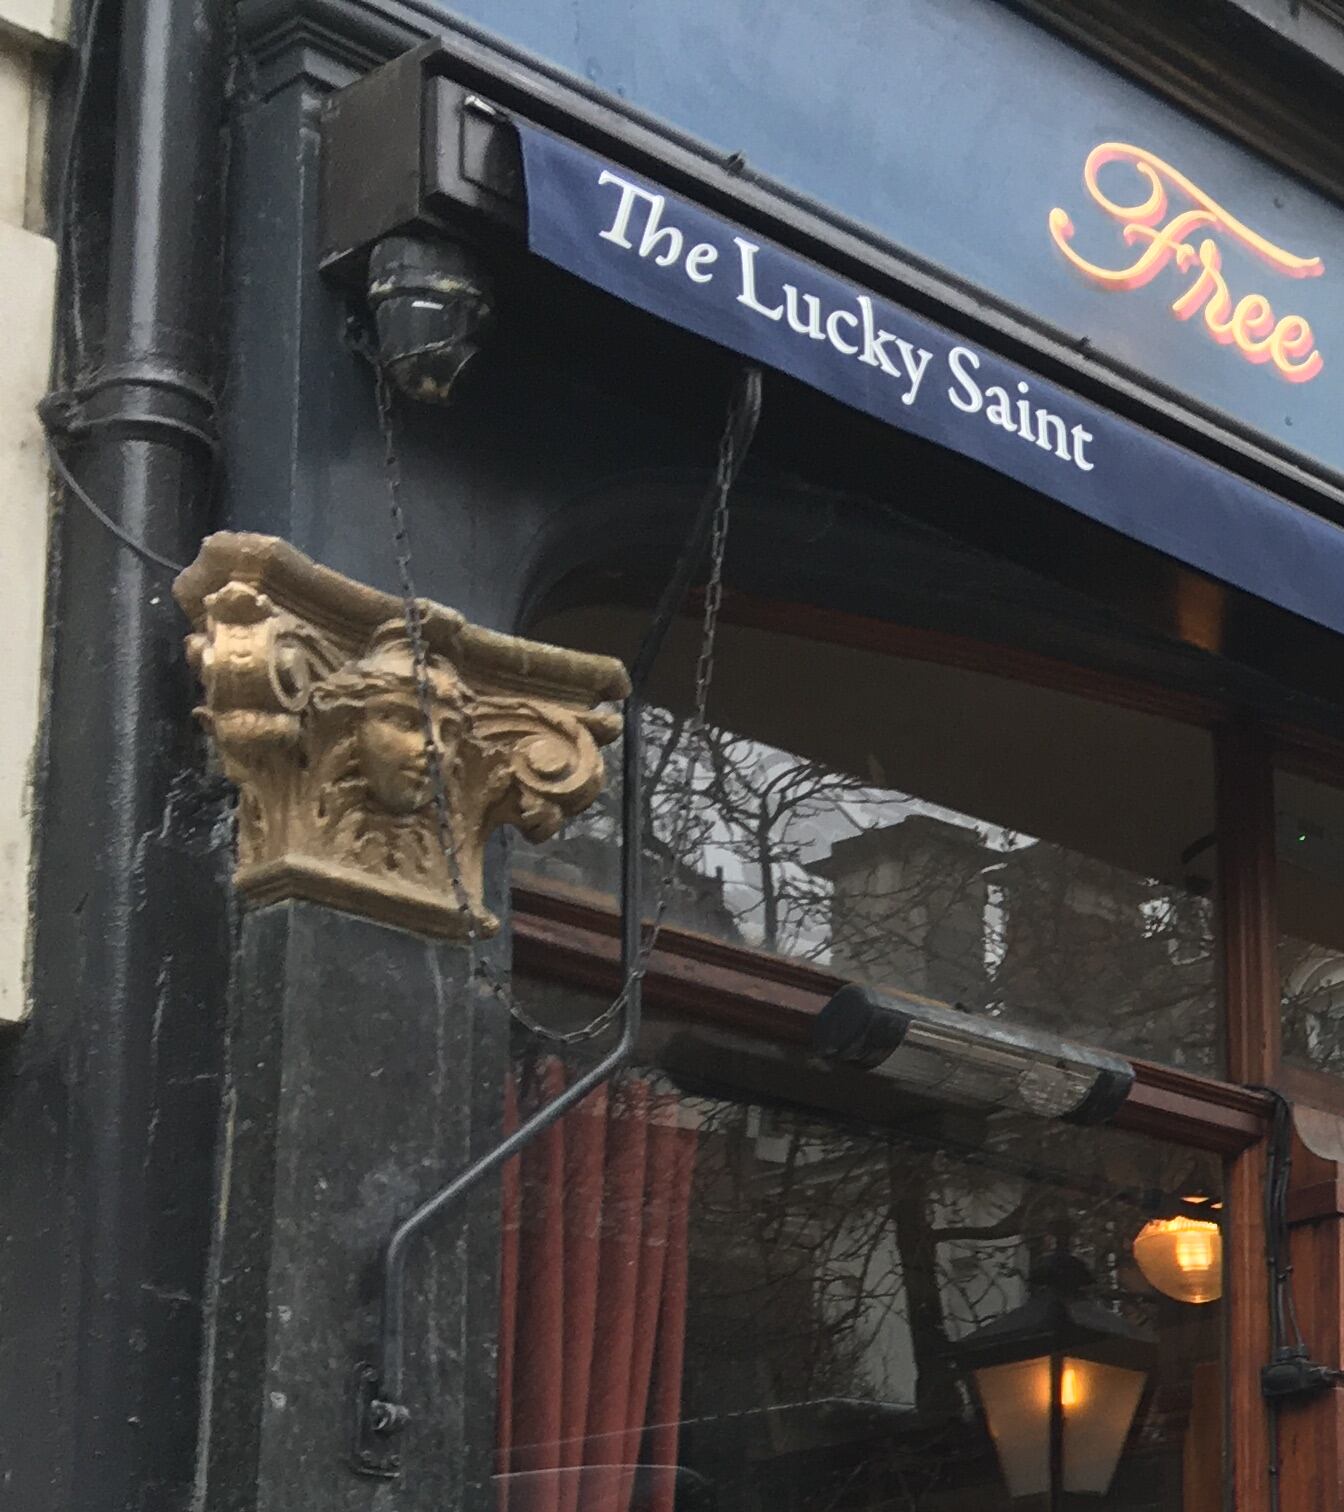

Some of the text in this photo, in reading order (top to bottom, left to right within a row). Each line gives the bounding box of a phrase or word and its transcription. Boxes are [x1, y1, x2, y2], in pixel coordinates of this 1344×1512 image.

[599, 170, 1094, 471] The Lucky Saint
[1048, 142, 1324, 382] Free
